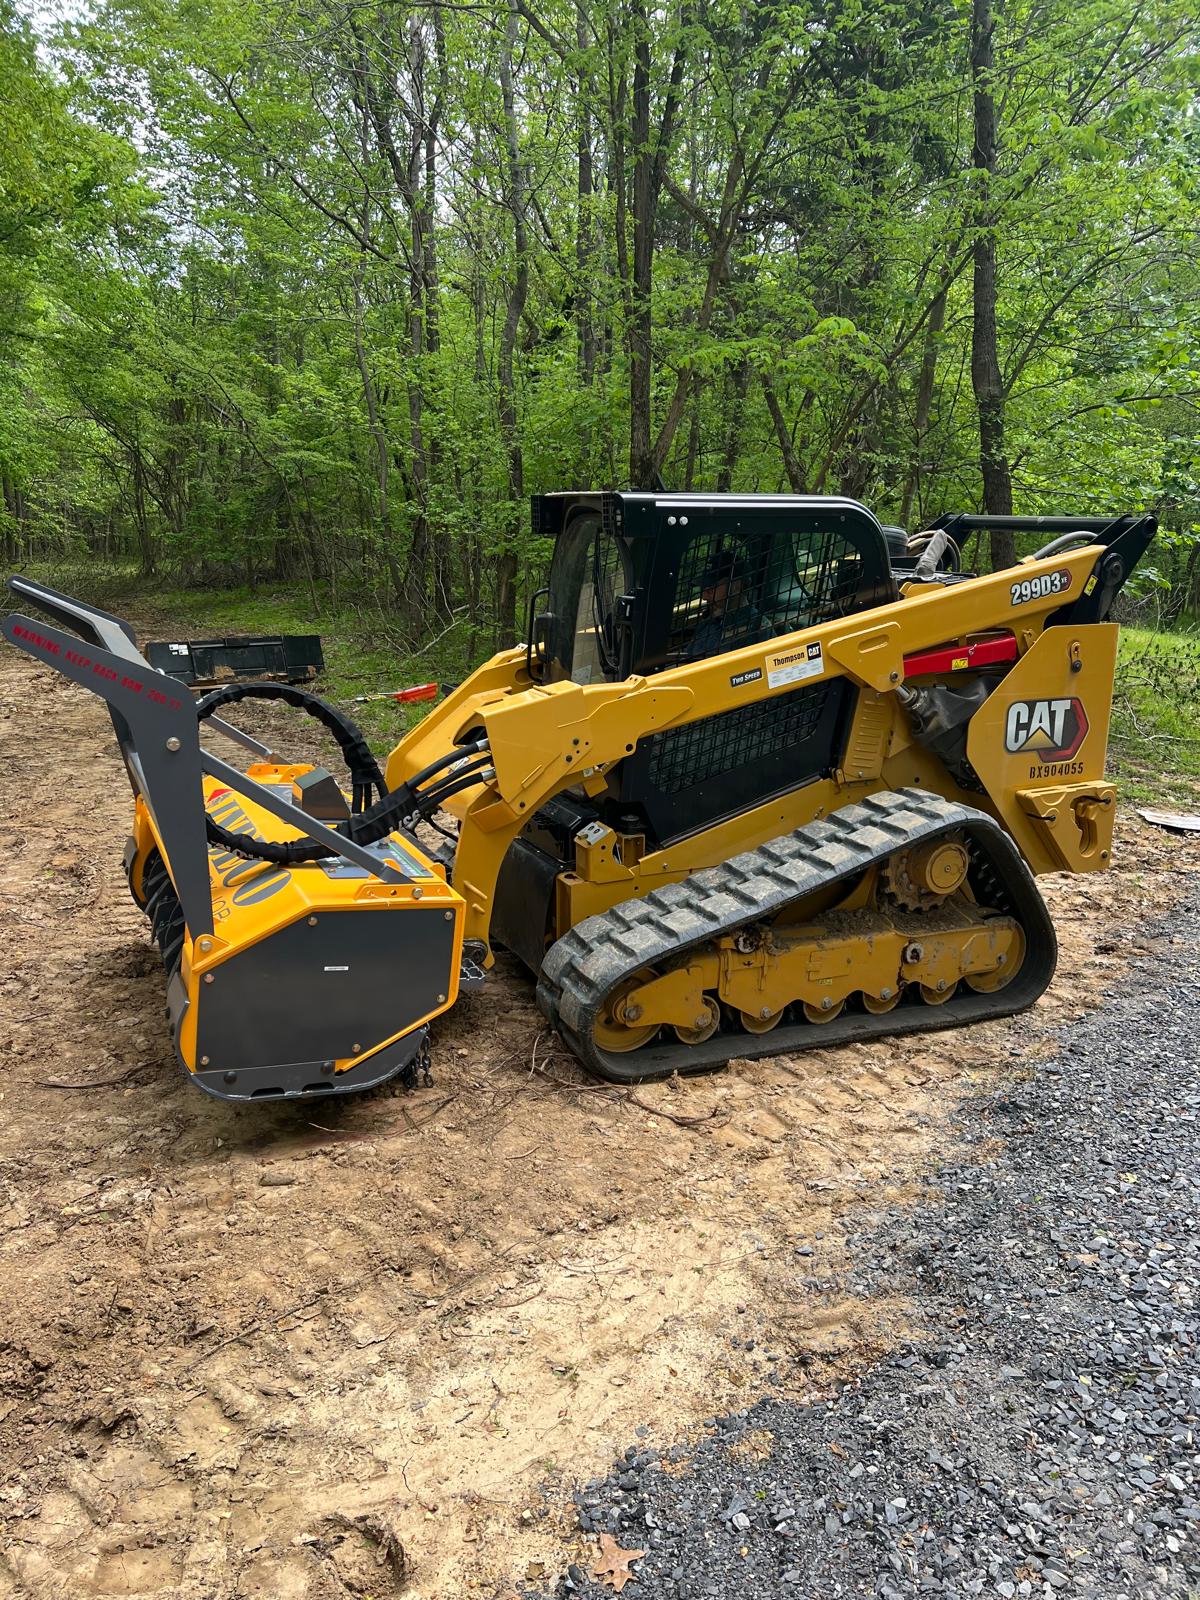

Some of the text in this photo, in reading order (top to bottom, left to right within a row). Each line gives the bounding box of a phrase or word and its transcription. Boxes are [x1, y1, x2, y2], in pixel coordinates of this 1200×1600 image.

[1011, 572, 1060, 605] 299D3
[12, 624, 61, 657] WARNING
[65, 650, 91, 668] KEEP
[93, 665, 117, 682] BACK
[773, 652, 805, 667] Thompson
[808, 646, 820, 657] CAT
[1006, 700, 1071, 752] CAT
[1029, 762, 1084, 779] BX904055
